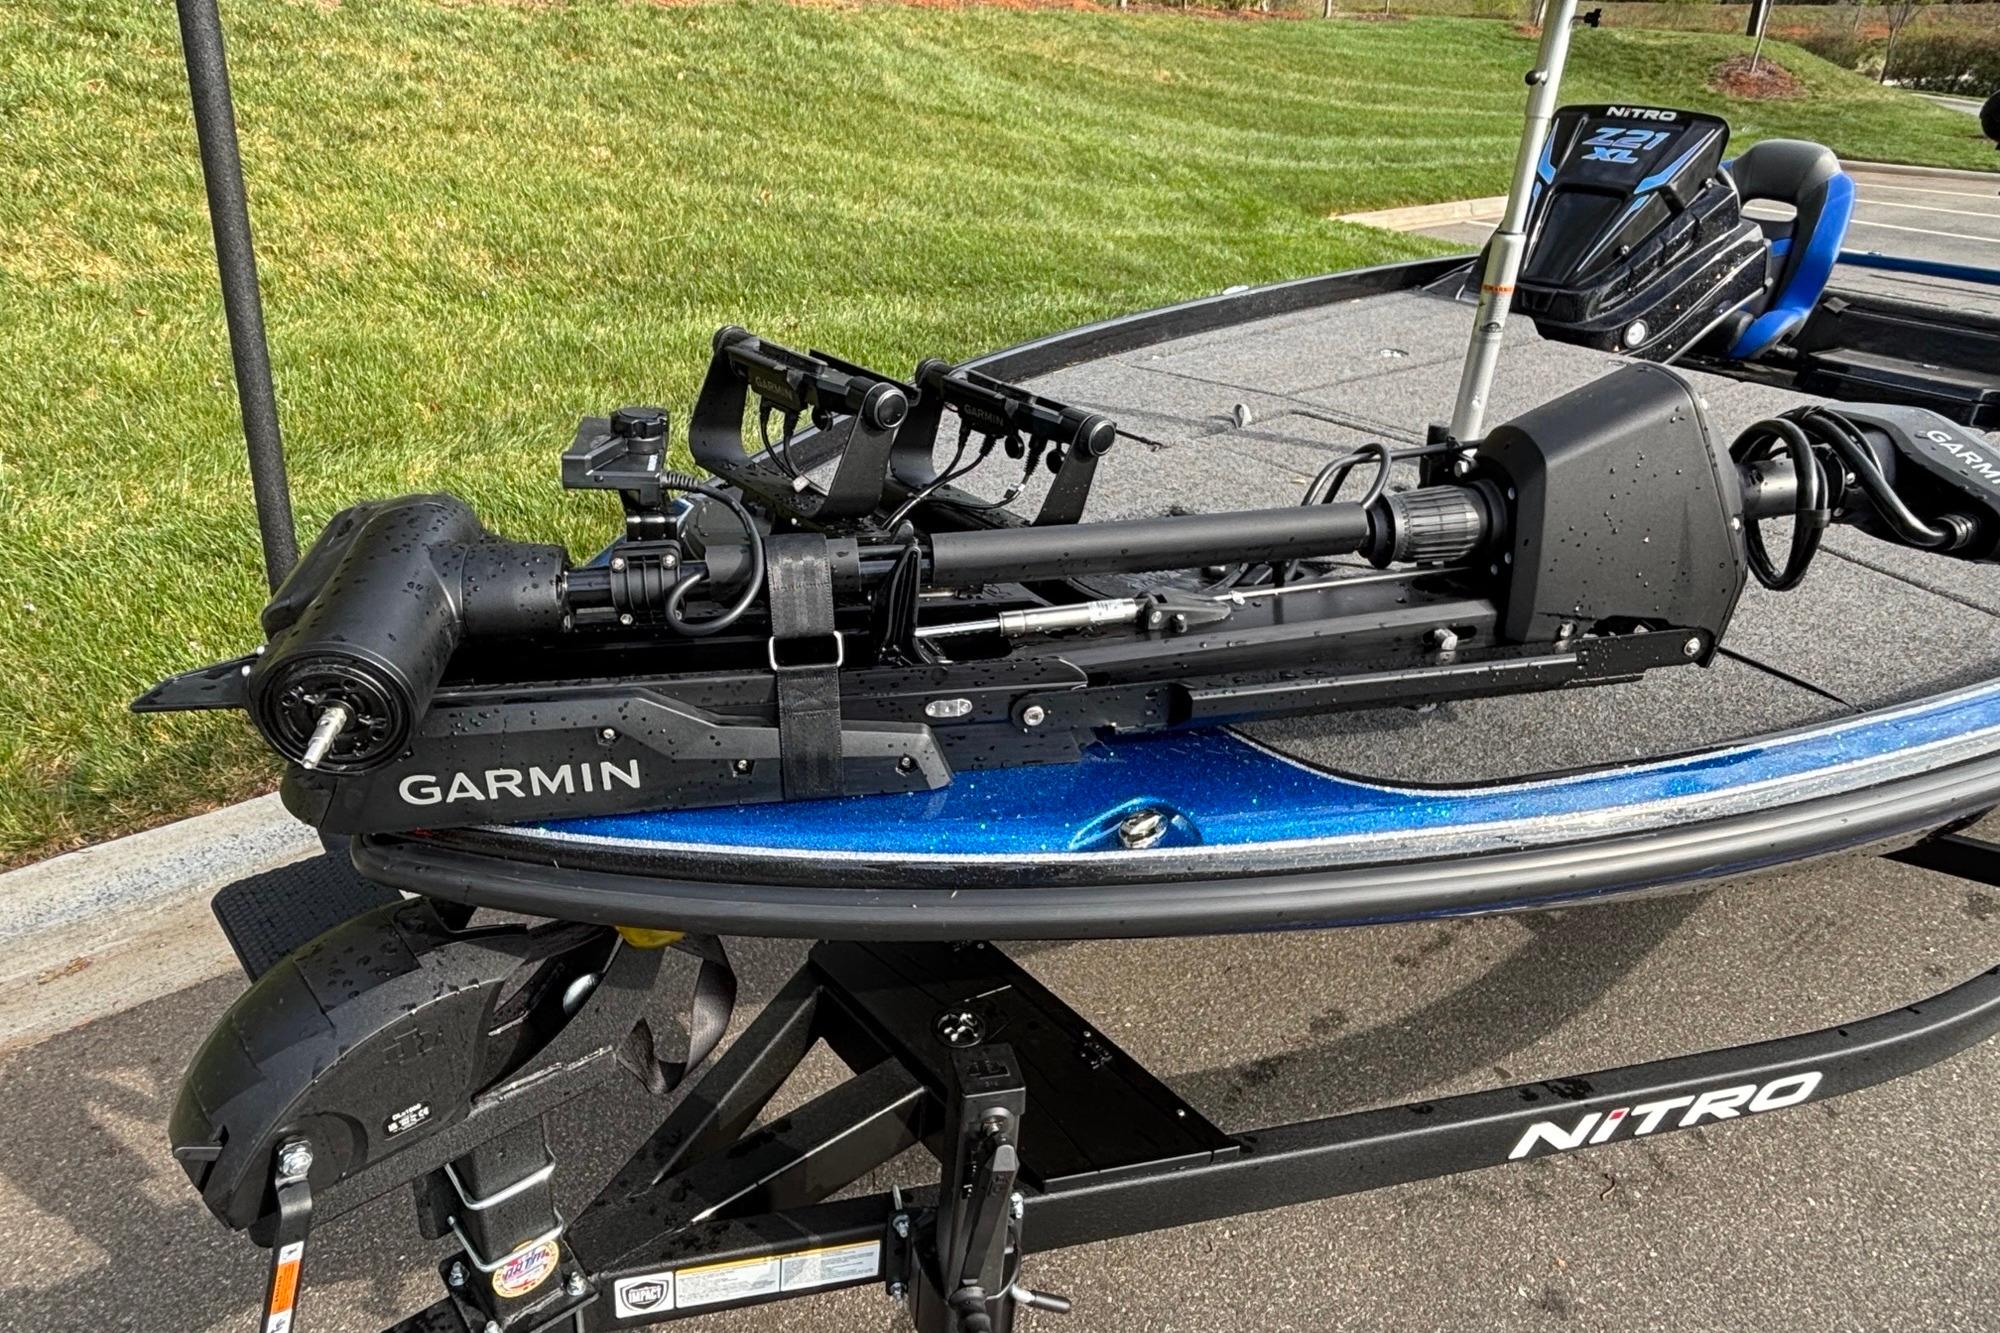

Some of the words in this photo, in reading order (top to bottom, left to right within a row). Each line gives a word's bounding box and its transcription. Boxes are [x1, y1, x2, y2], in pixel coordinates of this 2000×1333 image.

[1606, 106, 1677, 121] NITRO
[1582, 127, 1671, 150] Z21
[1581, 146, 1639, 164] XL
[963, 403, 1004, 427] GARMIN
[398, 759, 641, 806] GARMIN
[1507, 1071, 1823, 1160] NITRO
[628, 1285, 662, 1304] IMPACT
